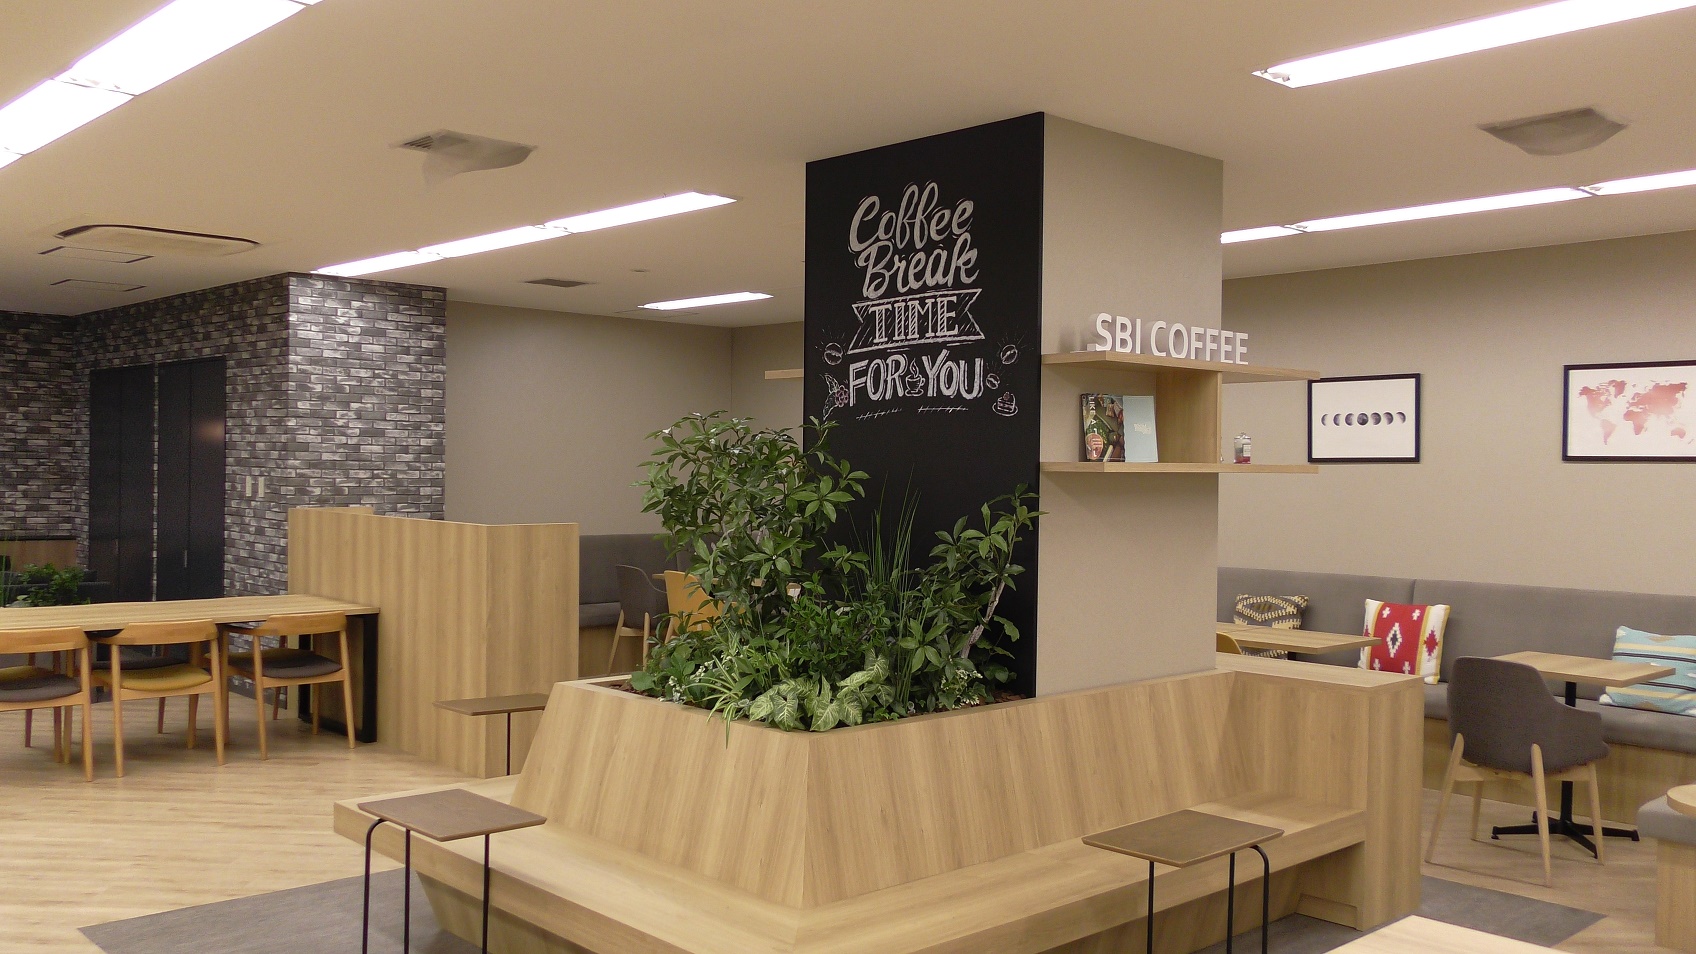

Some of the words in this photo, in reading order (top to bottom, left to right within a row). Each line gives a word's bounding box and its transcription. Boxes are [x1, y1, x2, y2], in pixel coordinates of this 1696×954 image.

[849, 180, 974, 253] Coffee
[856, 233, 979, 299] Break
[869, 296, 958, 343] TIME
[1096, 313, 1141, 354] SBI
[1150, 320, 1249, 365] COFFEE
[849, 354, 907, 407] FOR
[922, 349, 984, 400] YOU
[1088, 396, 1096, 416] LIKE
